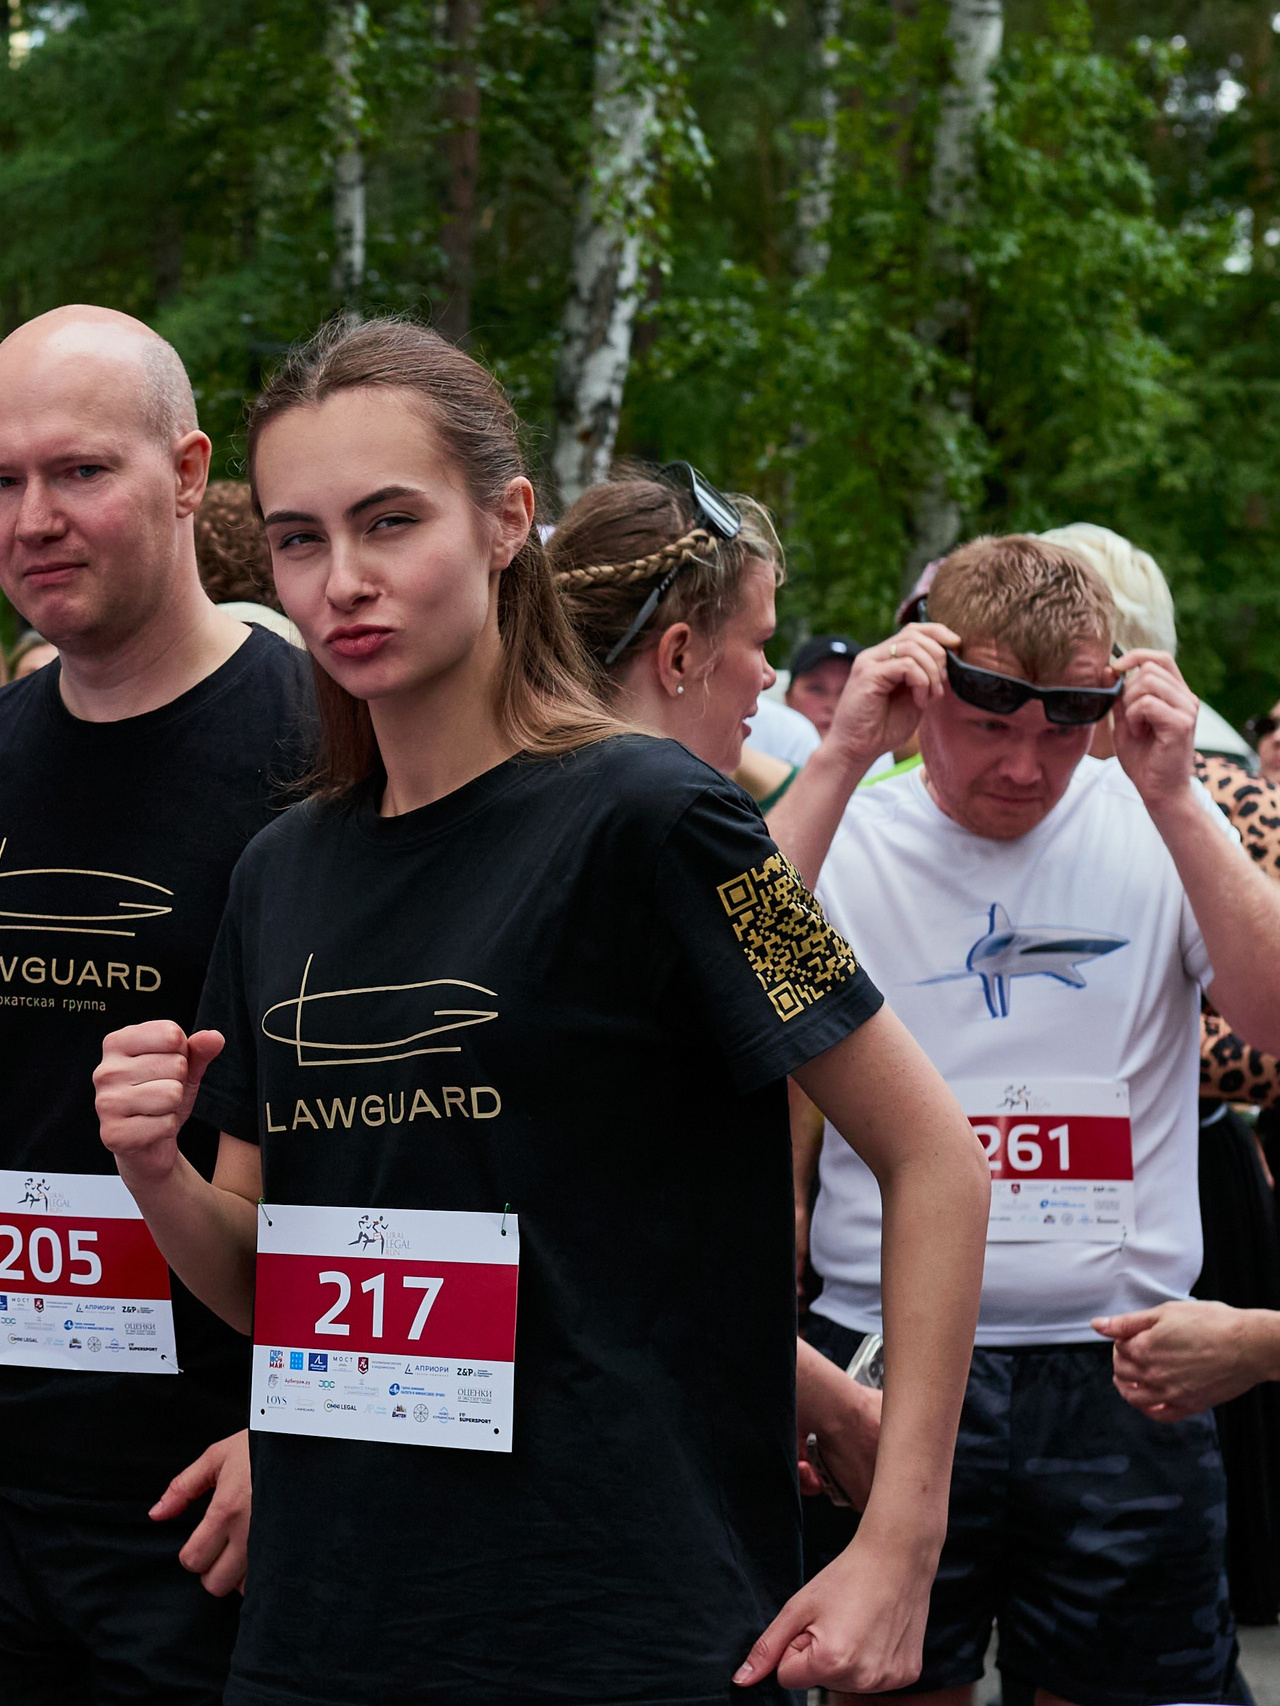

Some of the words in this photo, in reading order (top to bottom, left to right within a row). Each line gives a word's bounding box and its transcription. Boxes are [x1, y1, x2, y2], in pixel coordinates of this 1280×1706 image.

[62, 999, 107, 1011] группа
[266, 1086, 502, 1133] LAWGUARD
[972, 1123, 1070, 1172] 261
[386, 1239, 411, 1249] LEGAL
[314, 1270, 444, 1340] 217
[415, 1364, 450, 1373] АПРИОРИ
[457, 1367, 474, 1377] Z&P
[457, 1388, 493, 1398] ОЦЕНКИ
[266, 1395, 287, 1405] LOYS
[340, 1403, 357, 1411] LEGAL
